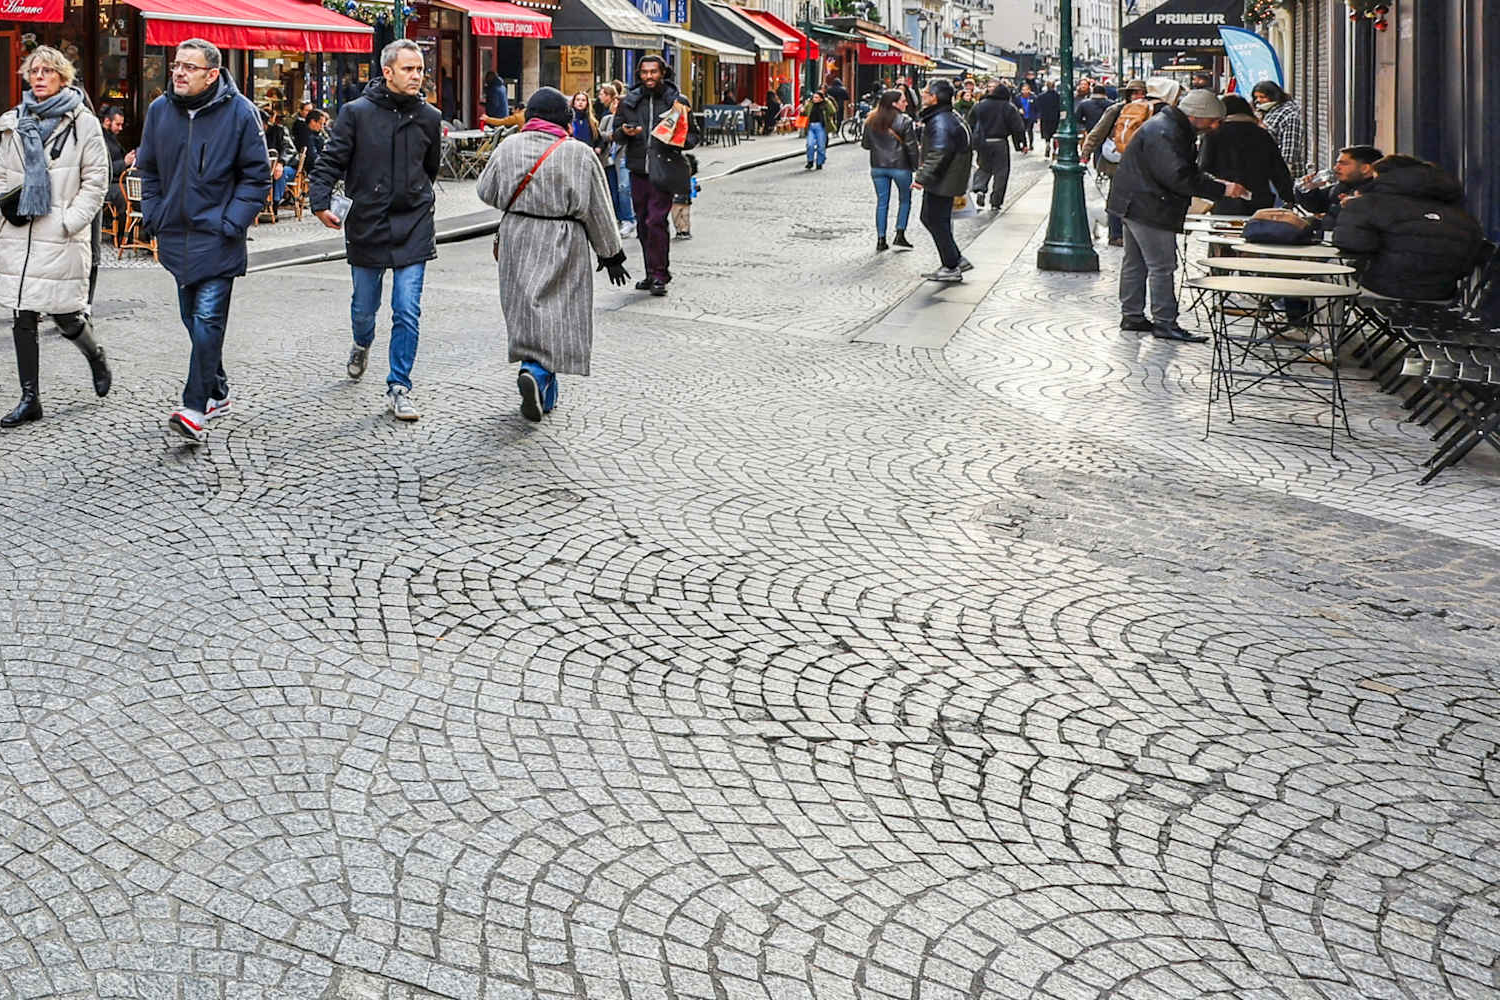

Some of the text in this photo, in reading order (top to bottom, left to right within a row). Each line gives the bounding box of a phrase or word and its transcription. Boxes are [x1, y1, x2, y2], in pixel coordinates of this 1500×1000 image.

[642, 0, 663, 18] GROM
[1155, 13, 1226, 25] PRIMEUR
[1161, 38, 1172, 46] 01
[1173, 38, 1185, 46] 42
[1187, 38, 1198, 46] 33
